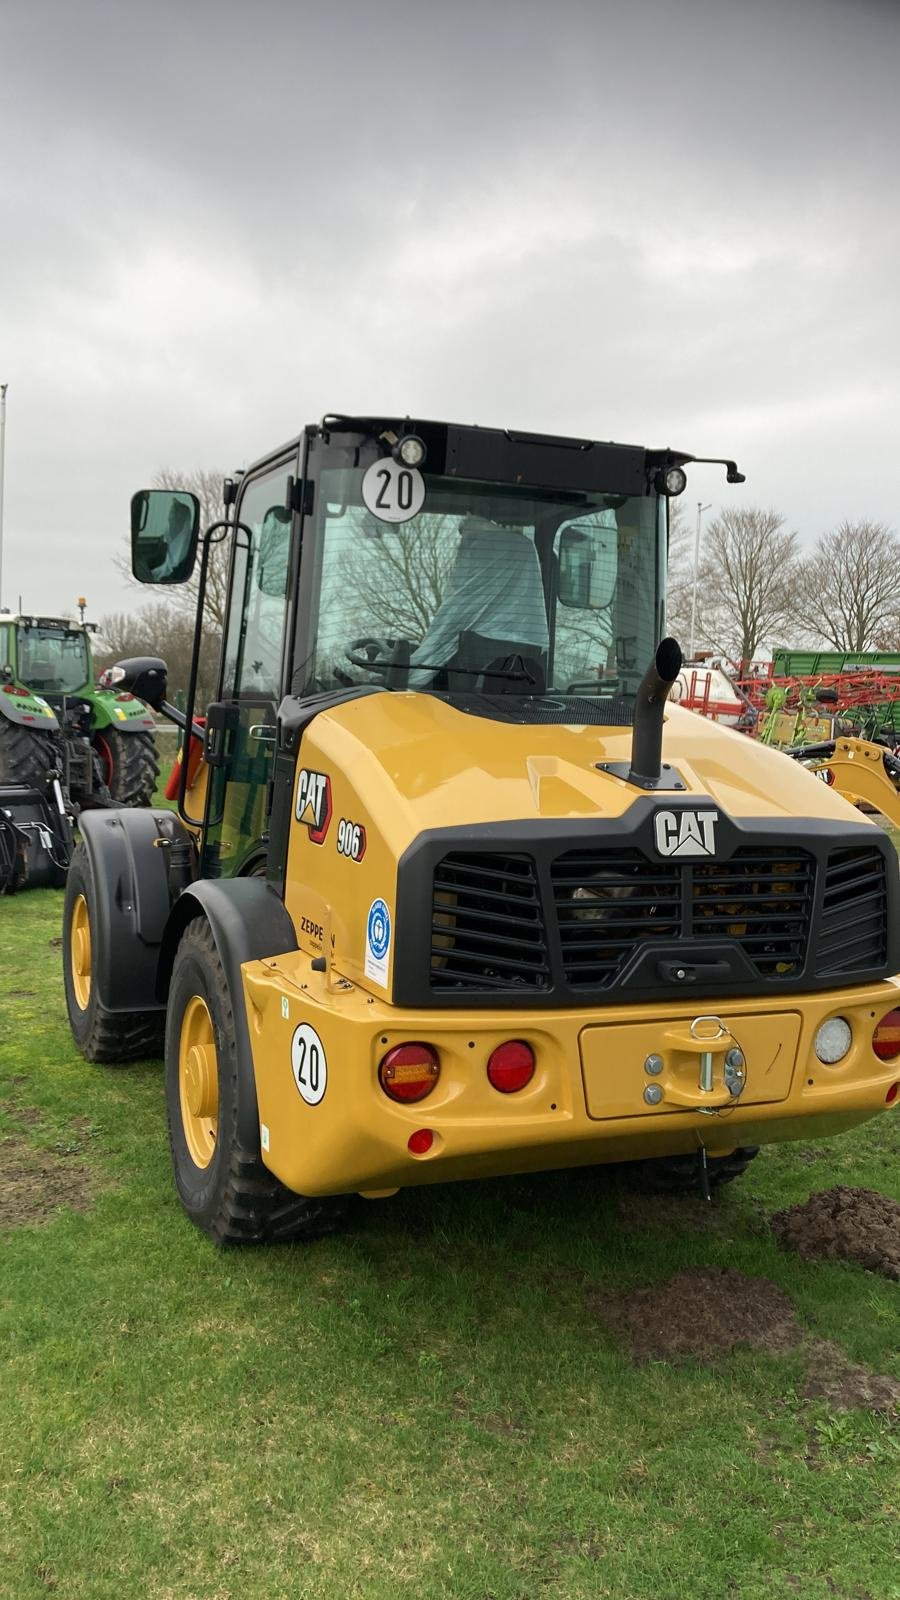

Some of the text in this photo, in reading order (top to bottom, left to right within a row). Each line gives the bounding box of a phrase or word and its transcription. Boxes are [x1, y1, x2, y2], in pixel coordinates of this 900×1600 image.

[375, 469, 414, 510] 20
[296, 769, 327, 828] CAT
[337, 819, 361, 859] 906
[655, 810, 719, 856] CAT
[298, 1036, 320, 1092] 20
